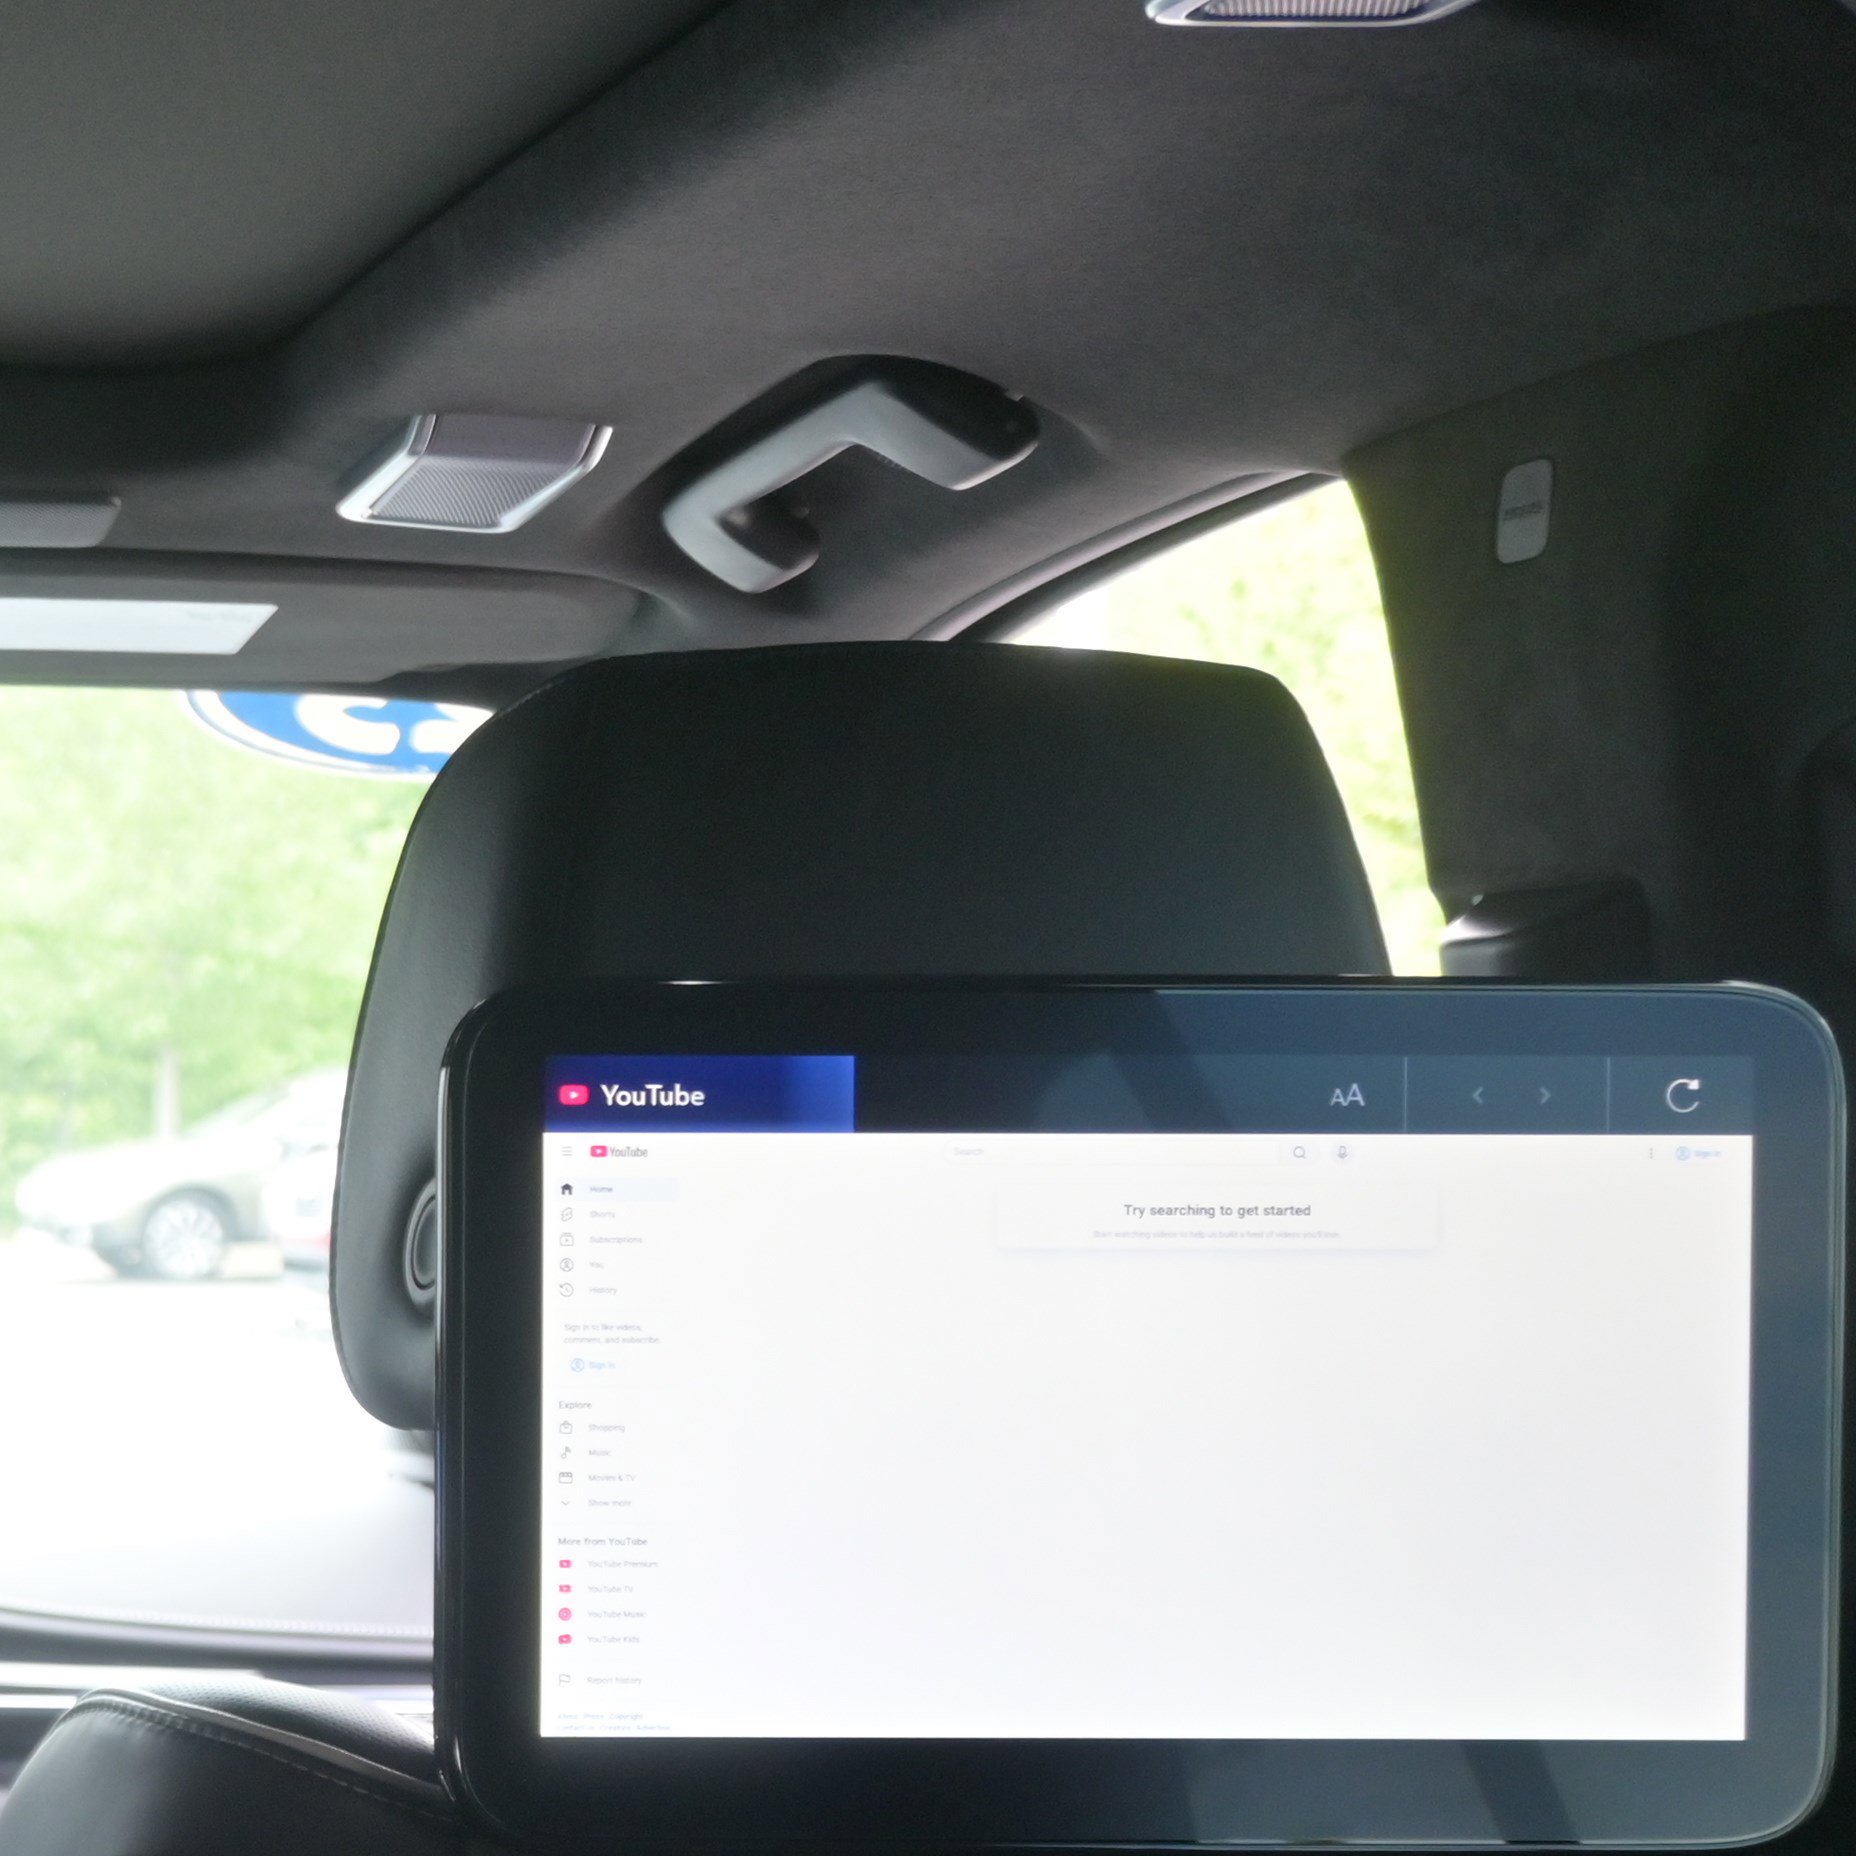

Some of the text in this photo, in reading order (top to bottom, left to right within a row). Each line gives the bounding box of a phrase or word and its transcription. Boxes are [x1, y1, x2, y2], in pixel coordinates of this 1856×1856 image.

[600, 1083, 706, 1107] YouTube
[609, 1146, 649, 1159] YouTube
[589, 1185, 614, 1194] Home
[589, 1210, 616, 1219] Shorts
[1123, 1204, 1311, 1219] Try searching to get started
[589, 1235, 643, 1246] Subscriptions
[589, 1286, 618, 1296] History
[589, 1360, 607, 1371] Sign
[558, 1400, 593, 1411] Explore
[588, 1423, 626, 1434] Shopping
[588, 1448, 612, 1458] Music
[588, 1473, 616, 1483] Movies
[587, 1498, 633, 1508] Show more
[558, 1536, 649, 1547] More from YouTube
[587, 1559, 659, 1569] YouTube Premium
[587, 1584, 622, 1594] YouTube
[587, 1609, 647, 1619] YouTube Music
[587, 1634, 621, 1645] YouTube
[586, 1675, 643, 1686] Report history
[608, 1712, 644, 1722] Copyright
